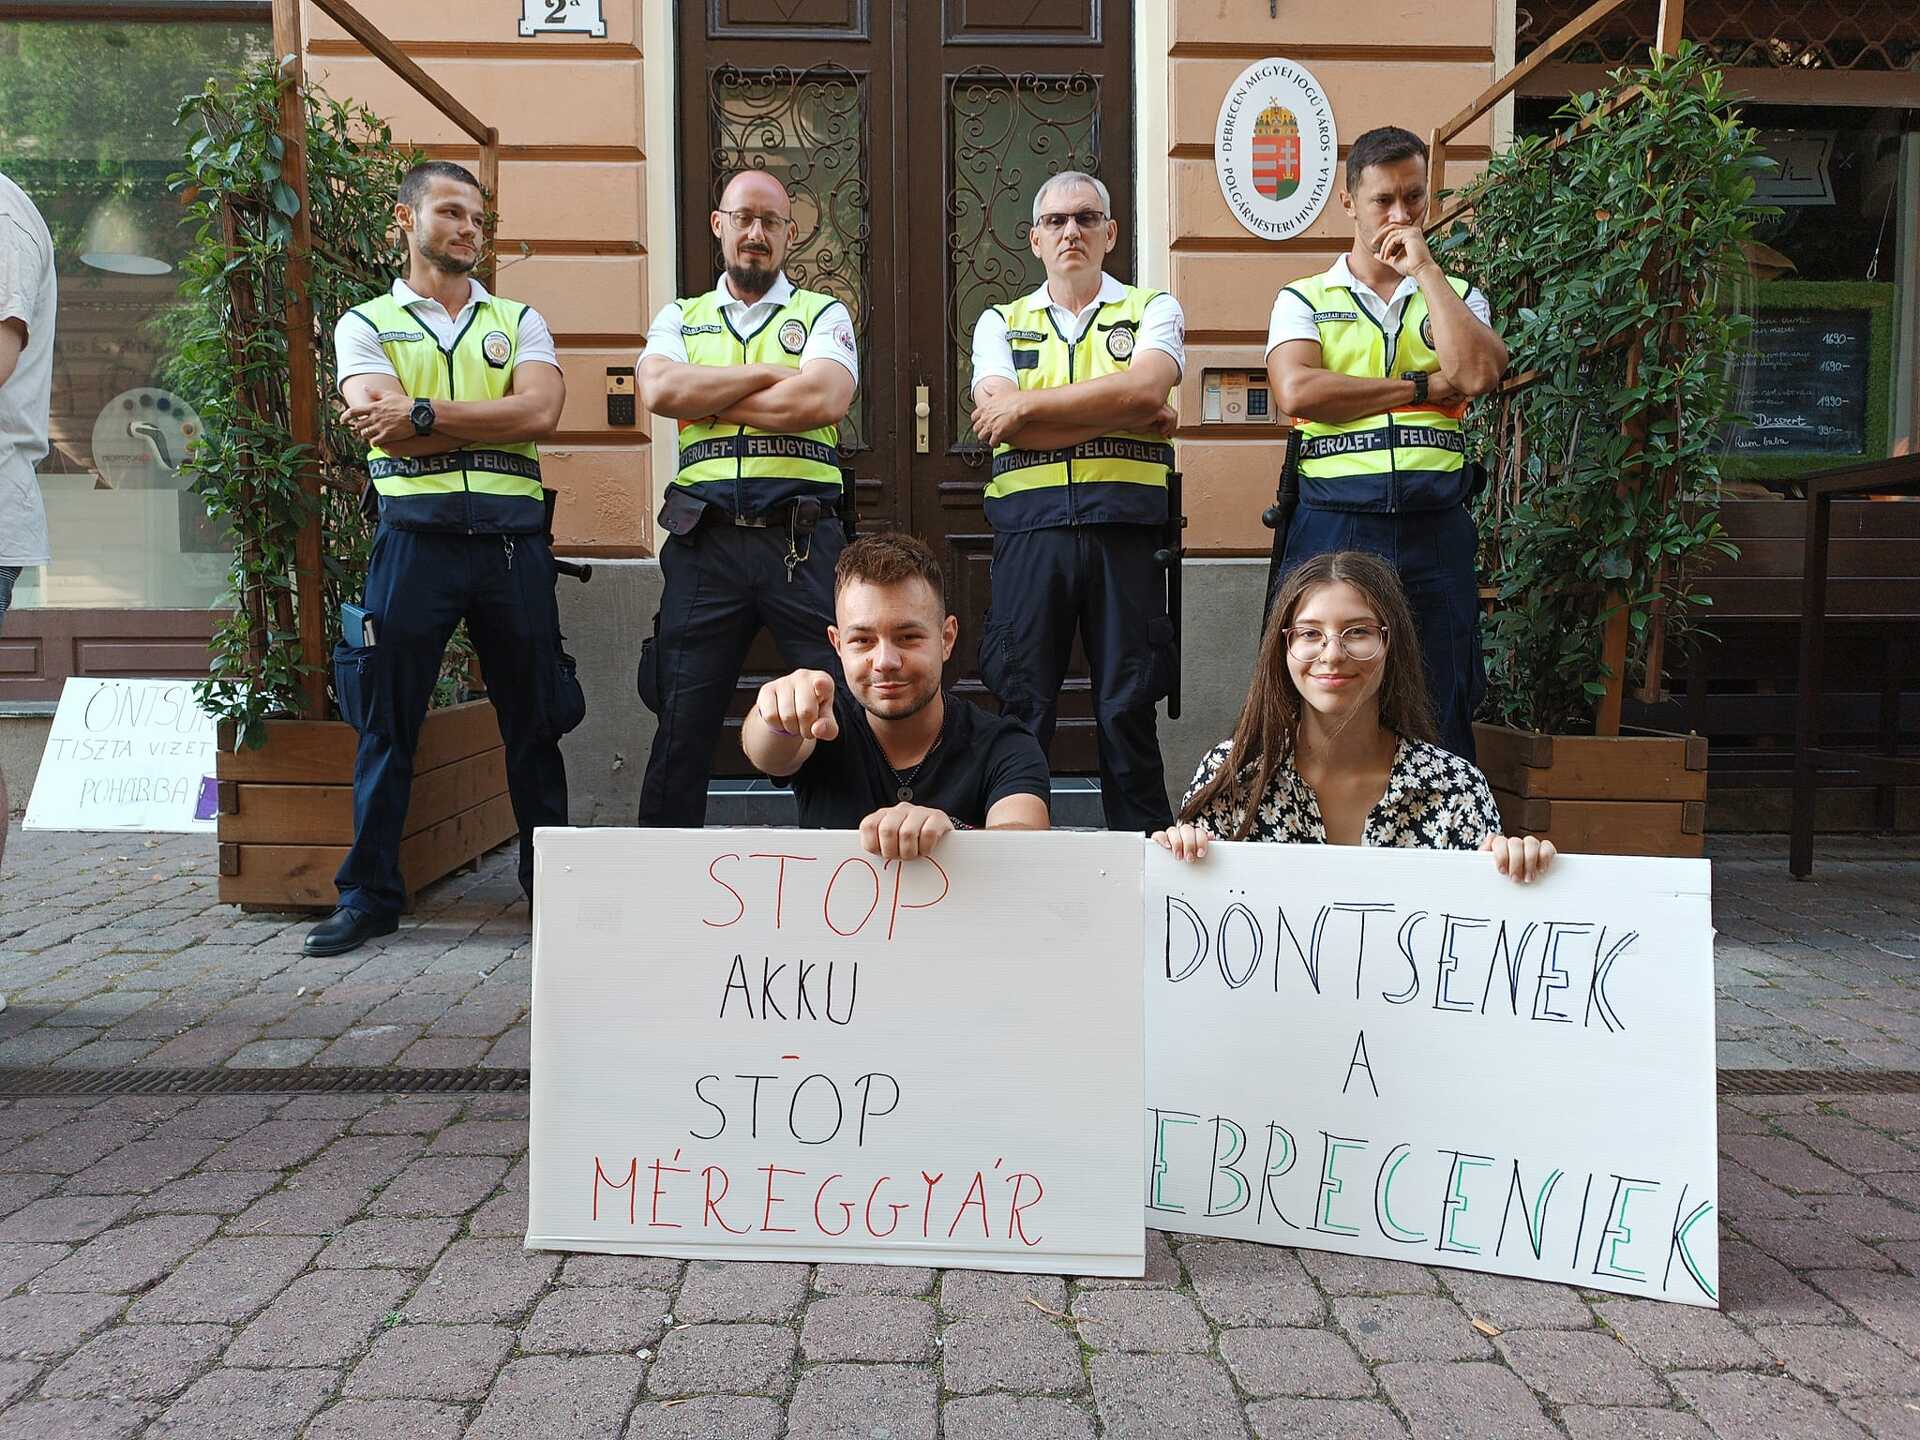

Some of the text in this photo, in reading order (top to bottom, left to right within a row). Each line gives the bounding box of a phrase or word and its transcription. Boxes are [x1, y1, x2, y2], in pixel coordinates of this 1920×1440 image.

[1222, 65, 1331, 152] DEBRECEN MEGYEI JOGÚ VÁROS
[1223, 167, 1330, 234] POLGÁRMESTERI HIVATALA
[747, 436, 830, 462] FELÜGYELET
[50, 738, 213, 761] TISZTA VIZET
[702, 853, 950, 941] STOP
[719, 953, 858, 1026] AKKU
[1165, 889, 1640, 1033] DÖNTSENEK
[1342, 1029, 1379, 1099] A
[689, 1072, 900, 1147] STOP
[593, 1148, 1045, 1247] MÉREGGYÁR
